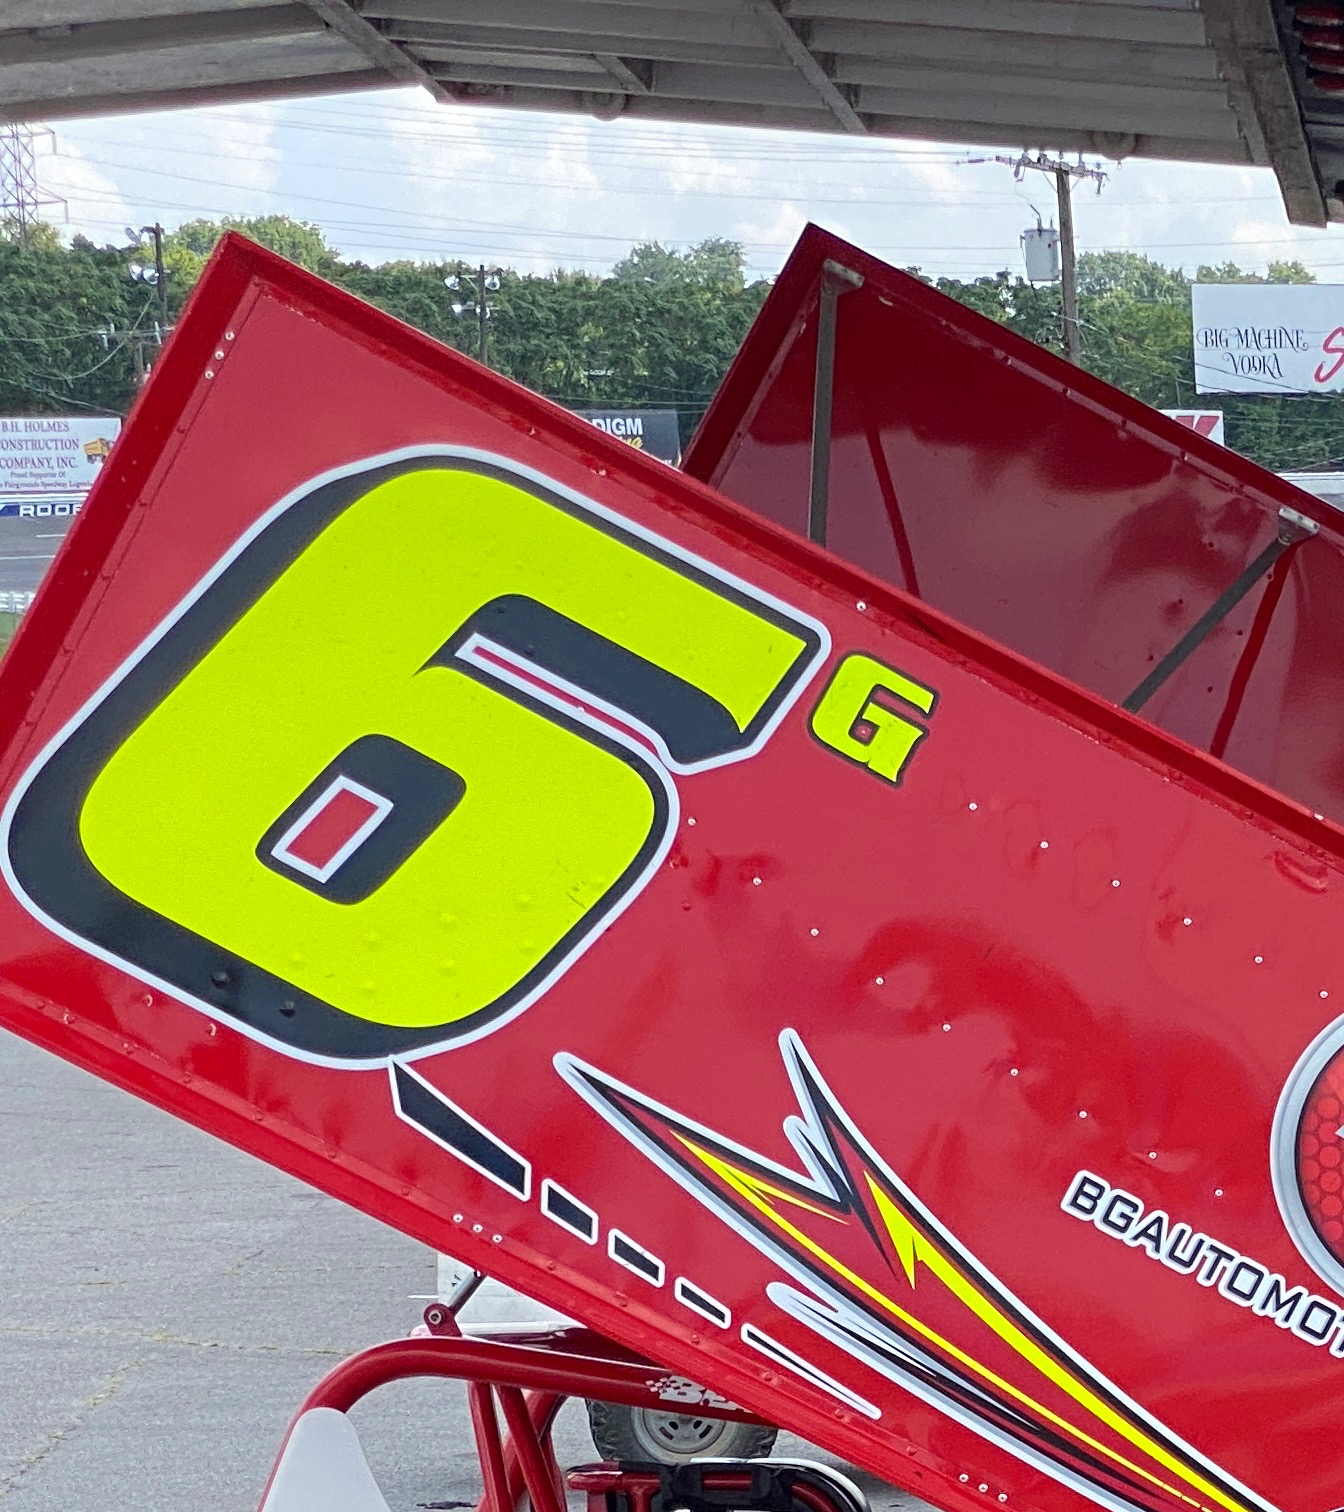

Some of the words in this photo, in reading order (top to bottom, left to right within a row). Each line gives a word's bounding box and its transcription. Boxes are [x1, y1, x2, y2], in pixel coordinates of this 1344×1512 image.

[1197, 328, 1229, 348] BIG
[1229, 326, 1309, 352] MACHINE
[1224, 352, 1284, 379] VODKA
[25, 421, 70, 432] HOLMES
[593, 418, 643, 435] DIGM
[0, 439, 80, 450] ONSTRUCTION
[12, 450, 828, 1062] 6
[808, 650, 938, 787] G
